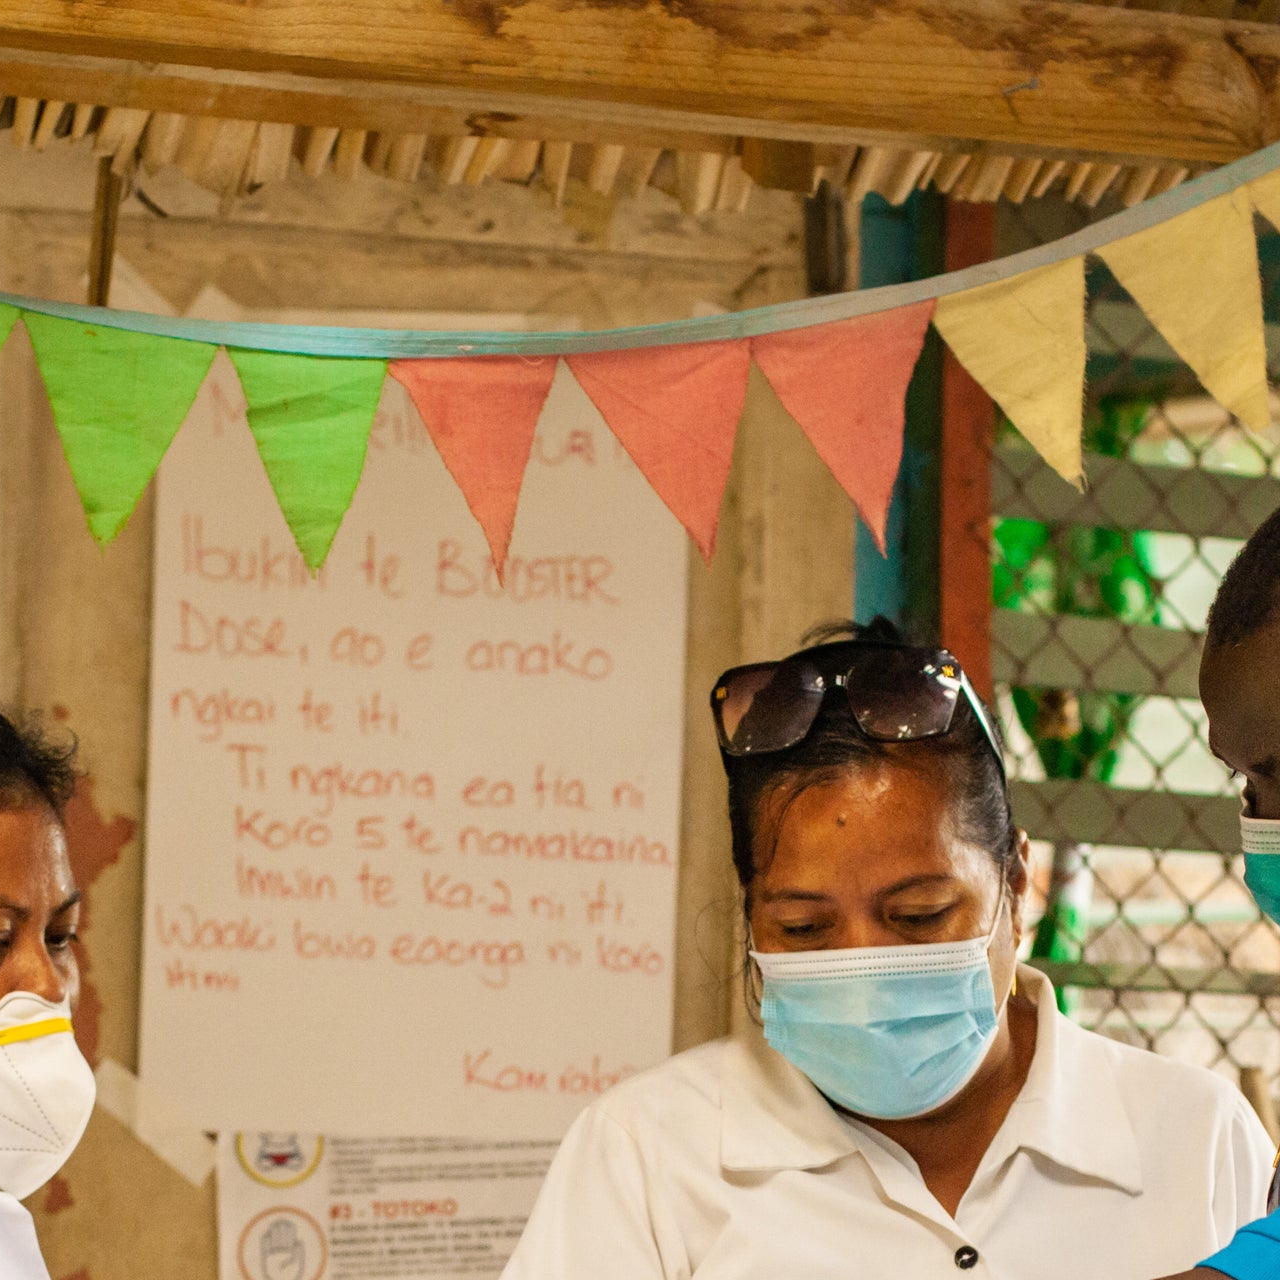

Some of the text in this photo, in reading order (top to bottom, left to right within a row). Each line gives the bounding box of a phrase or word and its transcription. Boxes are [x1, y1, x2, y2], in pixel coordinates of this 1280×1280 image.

[360, 530, 404, 598] te
[405, 632, 433, 672] e
[465, 627, 615, 683] anako
[298, 687, 334, 733] te
[355, 814, 387, 850] 5
[401, 810, 444, 857] te
[356, 860, 404, 909] te
